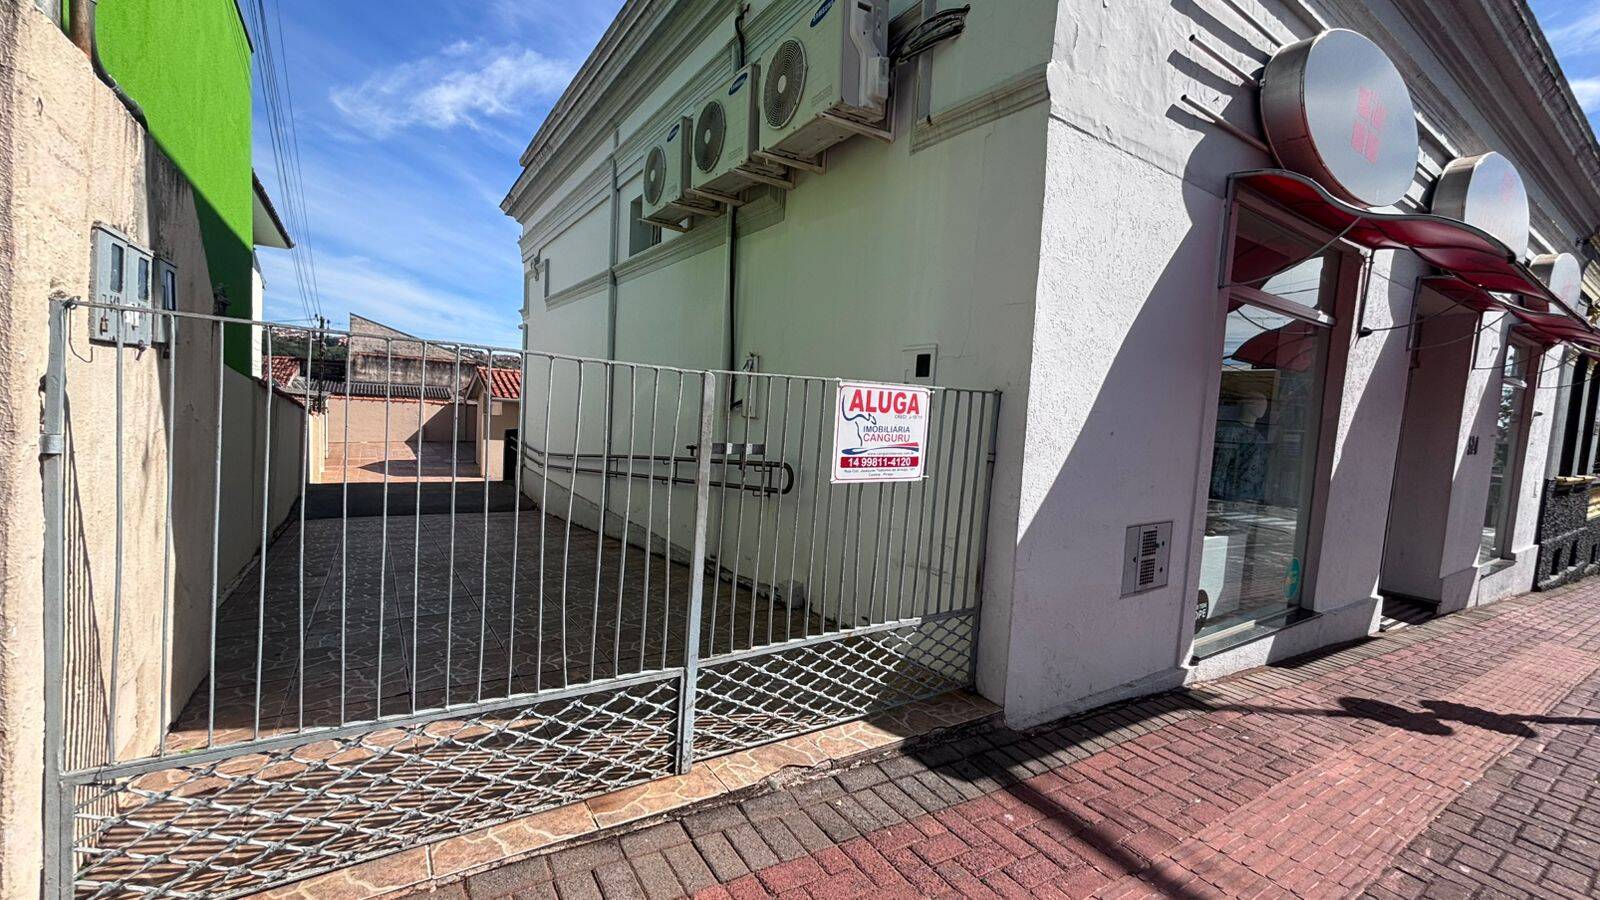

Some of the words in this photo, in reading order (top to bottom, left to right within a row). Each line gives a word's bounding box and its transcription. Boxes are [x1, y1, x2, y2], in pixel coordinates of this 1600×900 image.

[849, 389, 920, 415] ALUGA
[863, 433, 910, 442] CANGURU
[848, 457, 860, 467] 14
[861, 457, 911, 467] 99811-4120
